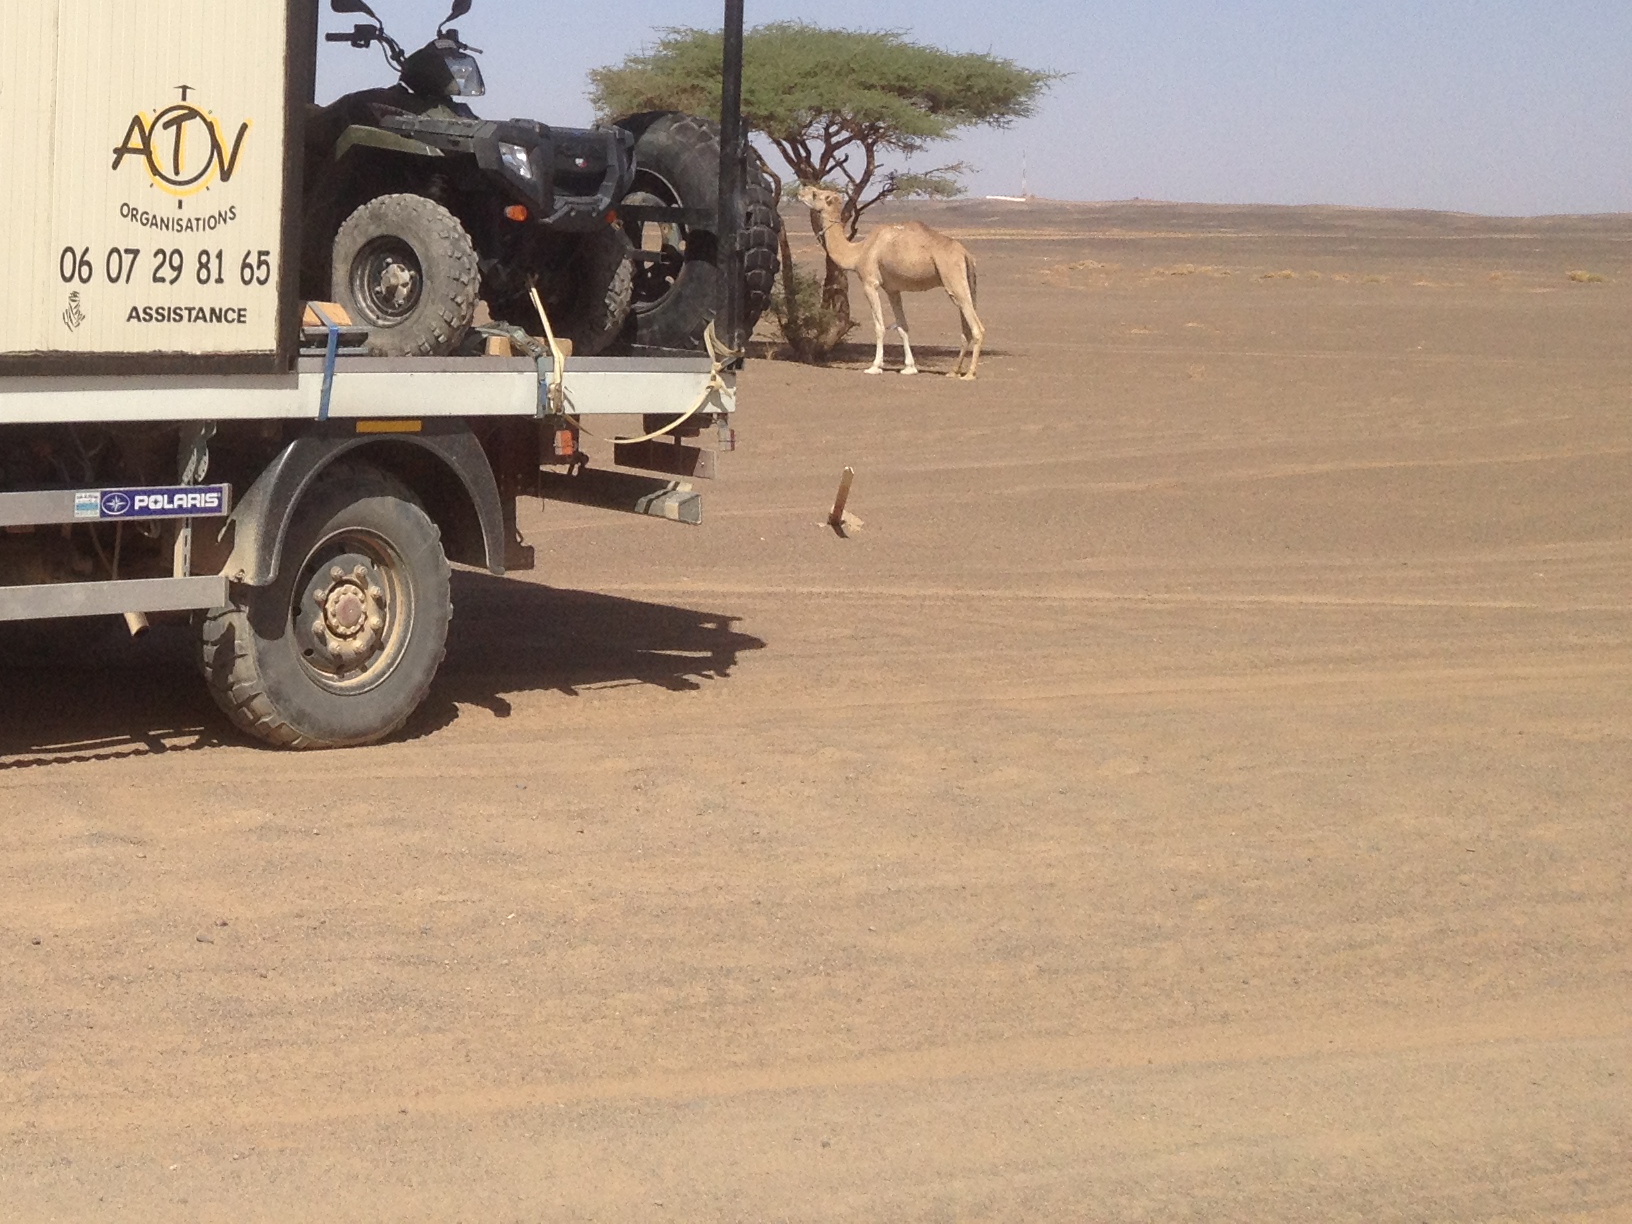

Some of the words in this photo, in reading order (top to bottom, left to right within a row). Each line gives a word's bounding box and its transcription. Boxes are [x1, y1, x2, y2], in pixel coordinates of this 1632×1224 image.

[112, 104, 249, 186] ATV
[120, 202, 237, 233] ORGANISATIONS
[59, 246, 93, 284] 06
[106, 246, 140, 284] 07
[152, 248, 184, 285] 29
[196, 249, 225, 285] 81
[240, 250, 271, 286] 65
[126, 306, 248, 324] ASSISTANCE
[134, 492, 218, 510] POLARIS
